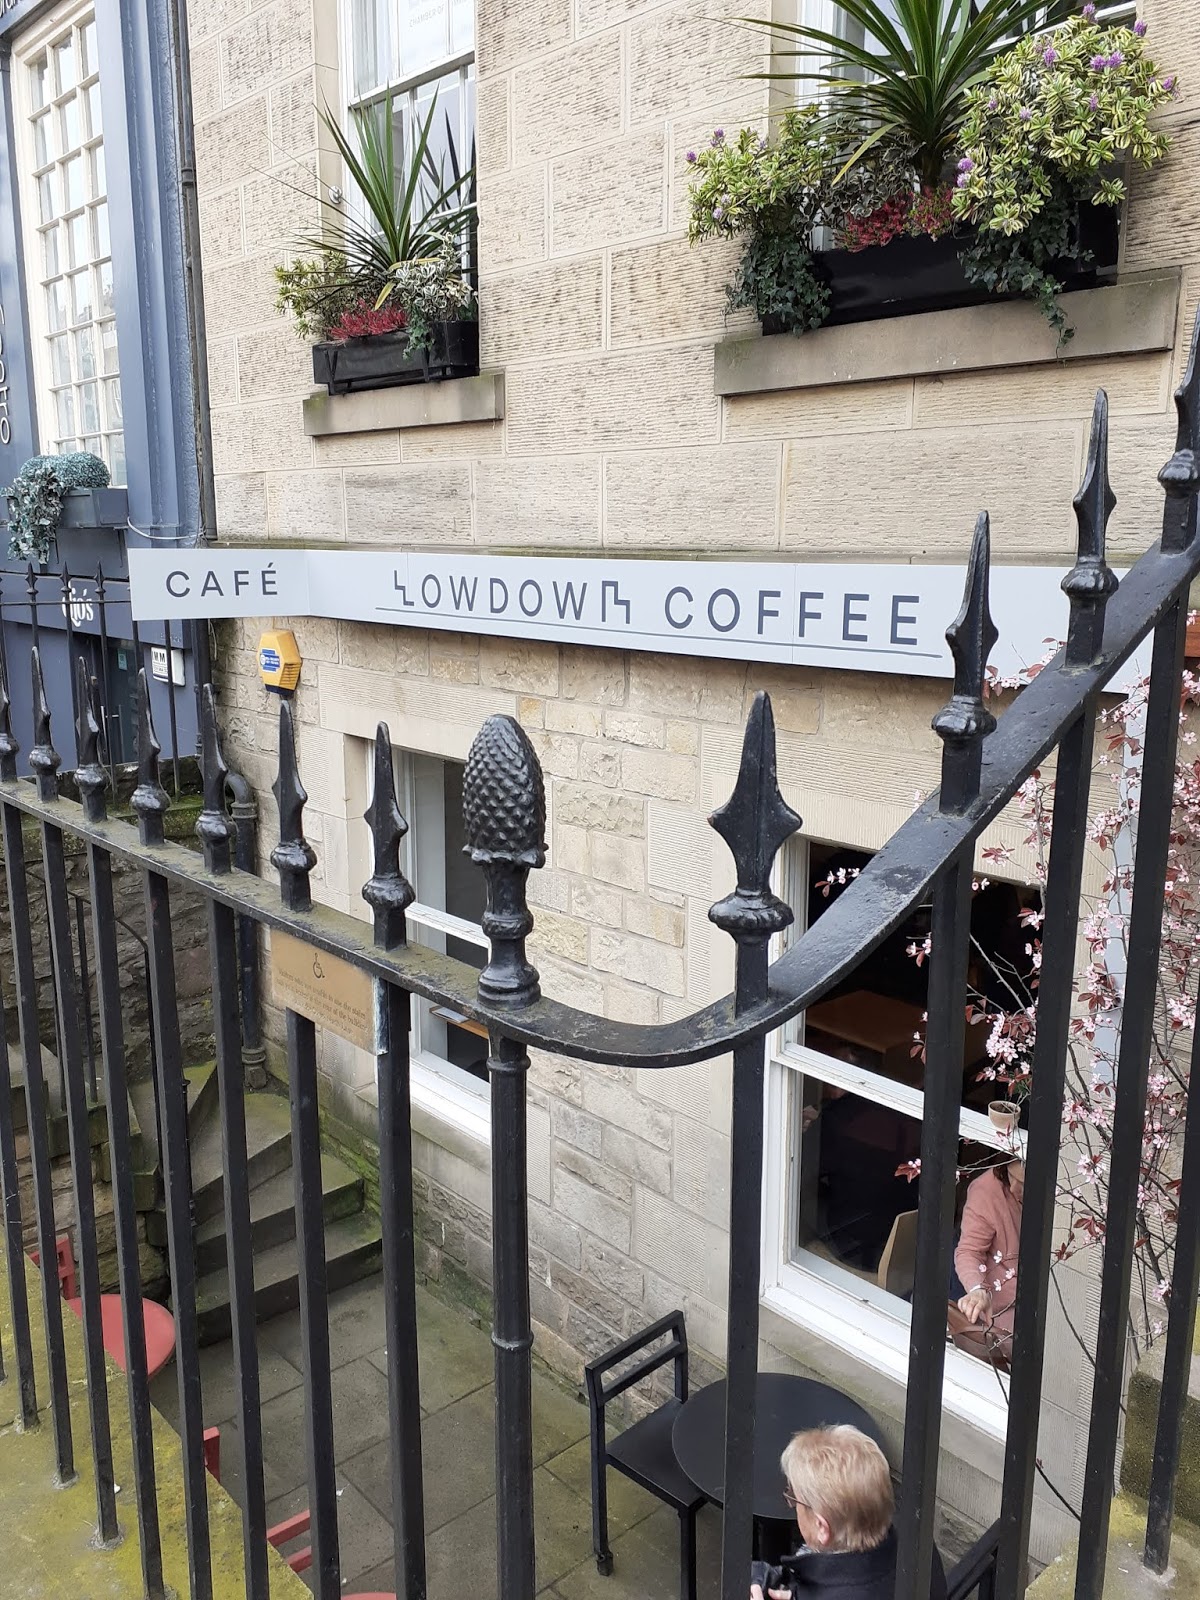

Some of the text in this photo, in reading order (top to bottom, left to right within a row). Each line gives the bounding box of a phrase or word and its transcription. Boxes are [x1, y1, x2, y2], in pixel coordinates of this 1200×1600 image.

[166, 562, 278, 598] CAFÉ
[394, 570, 920, 646] LOWDOWN COFFEE
